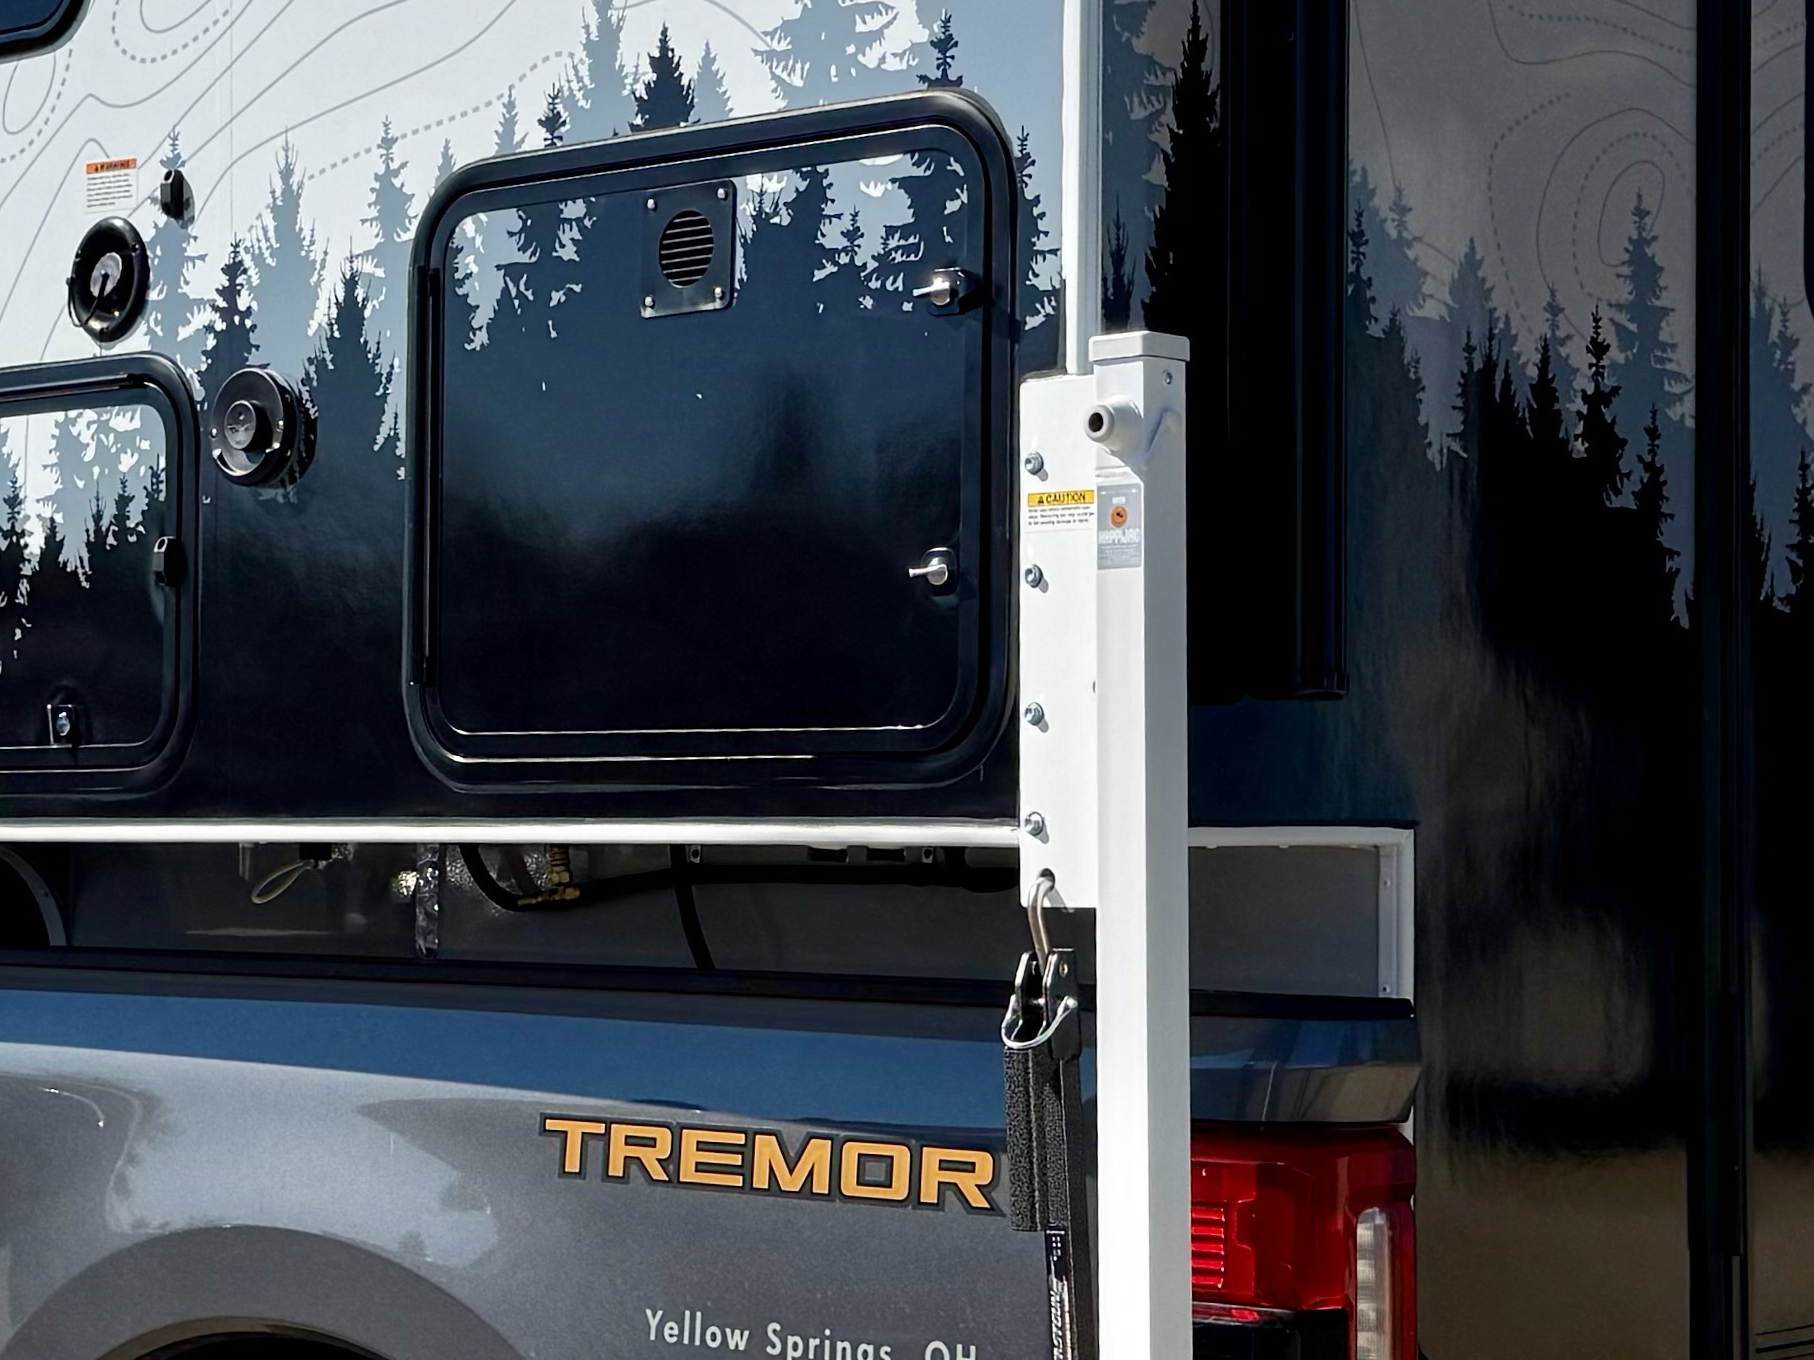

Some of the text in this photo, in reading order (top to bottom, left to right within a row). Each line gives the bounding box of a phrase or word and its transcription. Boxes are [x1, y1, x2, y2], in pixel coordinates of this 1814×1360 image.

[1045, 492, 1086, 505] CAUTION
[542, 1116, 998, 1212] TREMOR
[645, 1308, 750, 1352] Yellow
